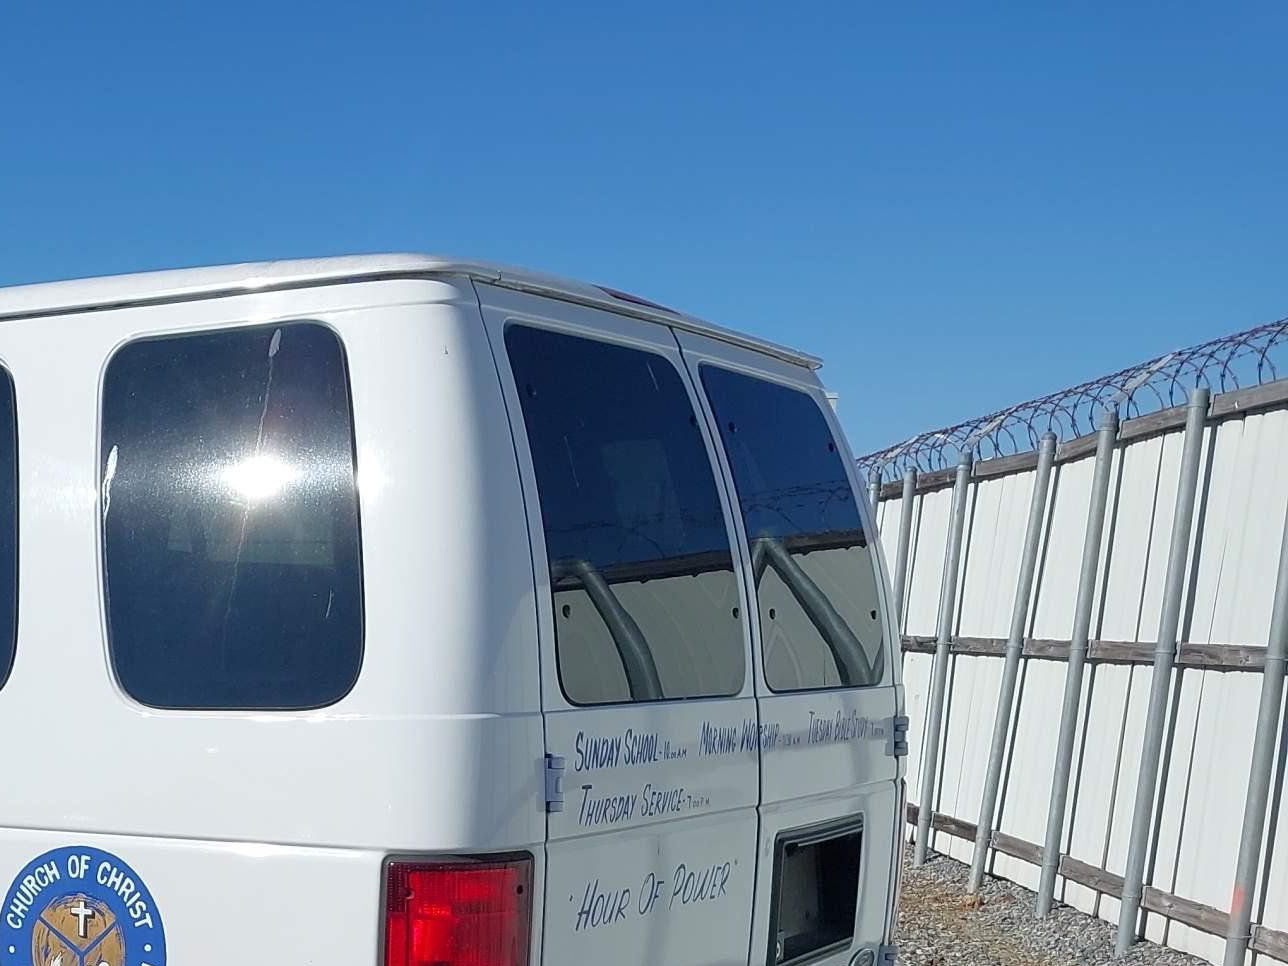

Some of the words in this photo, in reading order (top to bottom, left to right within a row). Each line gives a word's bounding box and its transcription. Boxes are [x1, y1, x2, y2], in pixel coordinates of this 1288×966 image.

[575, 730, 622, 772] SUNDAY
[699, 720, 737, 757] MORNING
[579, 784, 637, 827] THURSDAY
[6, 860, 61, 929] CHURCH
[67, 855, 91, 879] OF
[96, 861, 154, 929] CHRIST
[638, 872, 665, 916] OF
